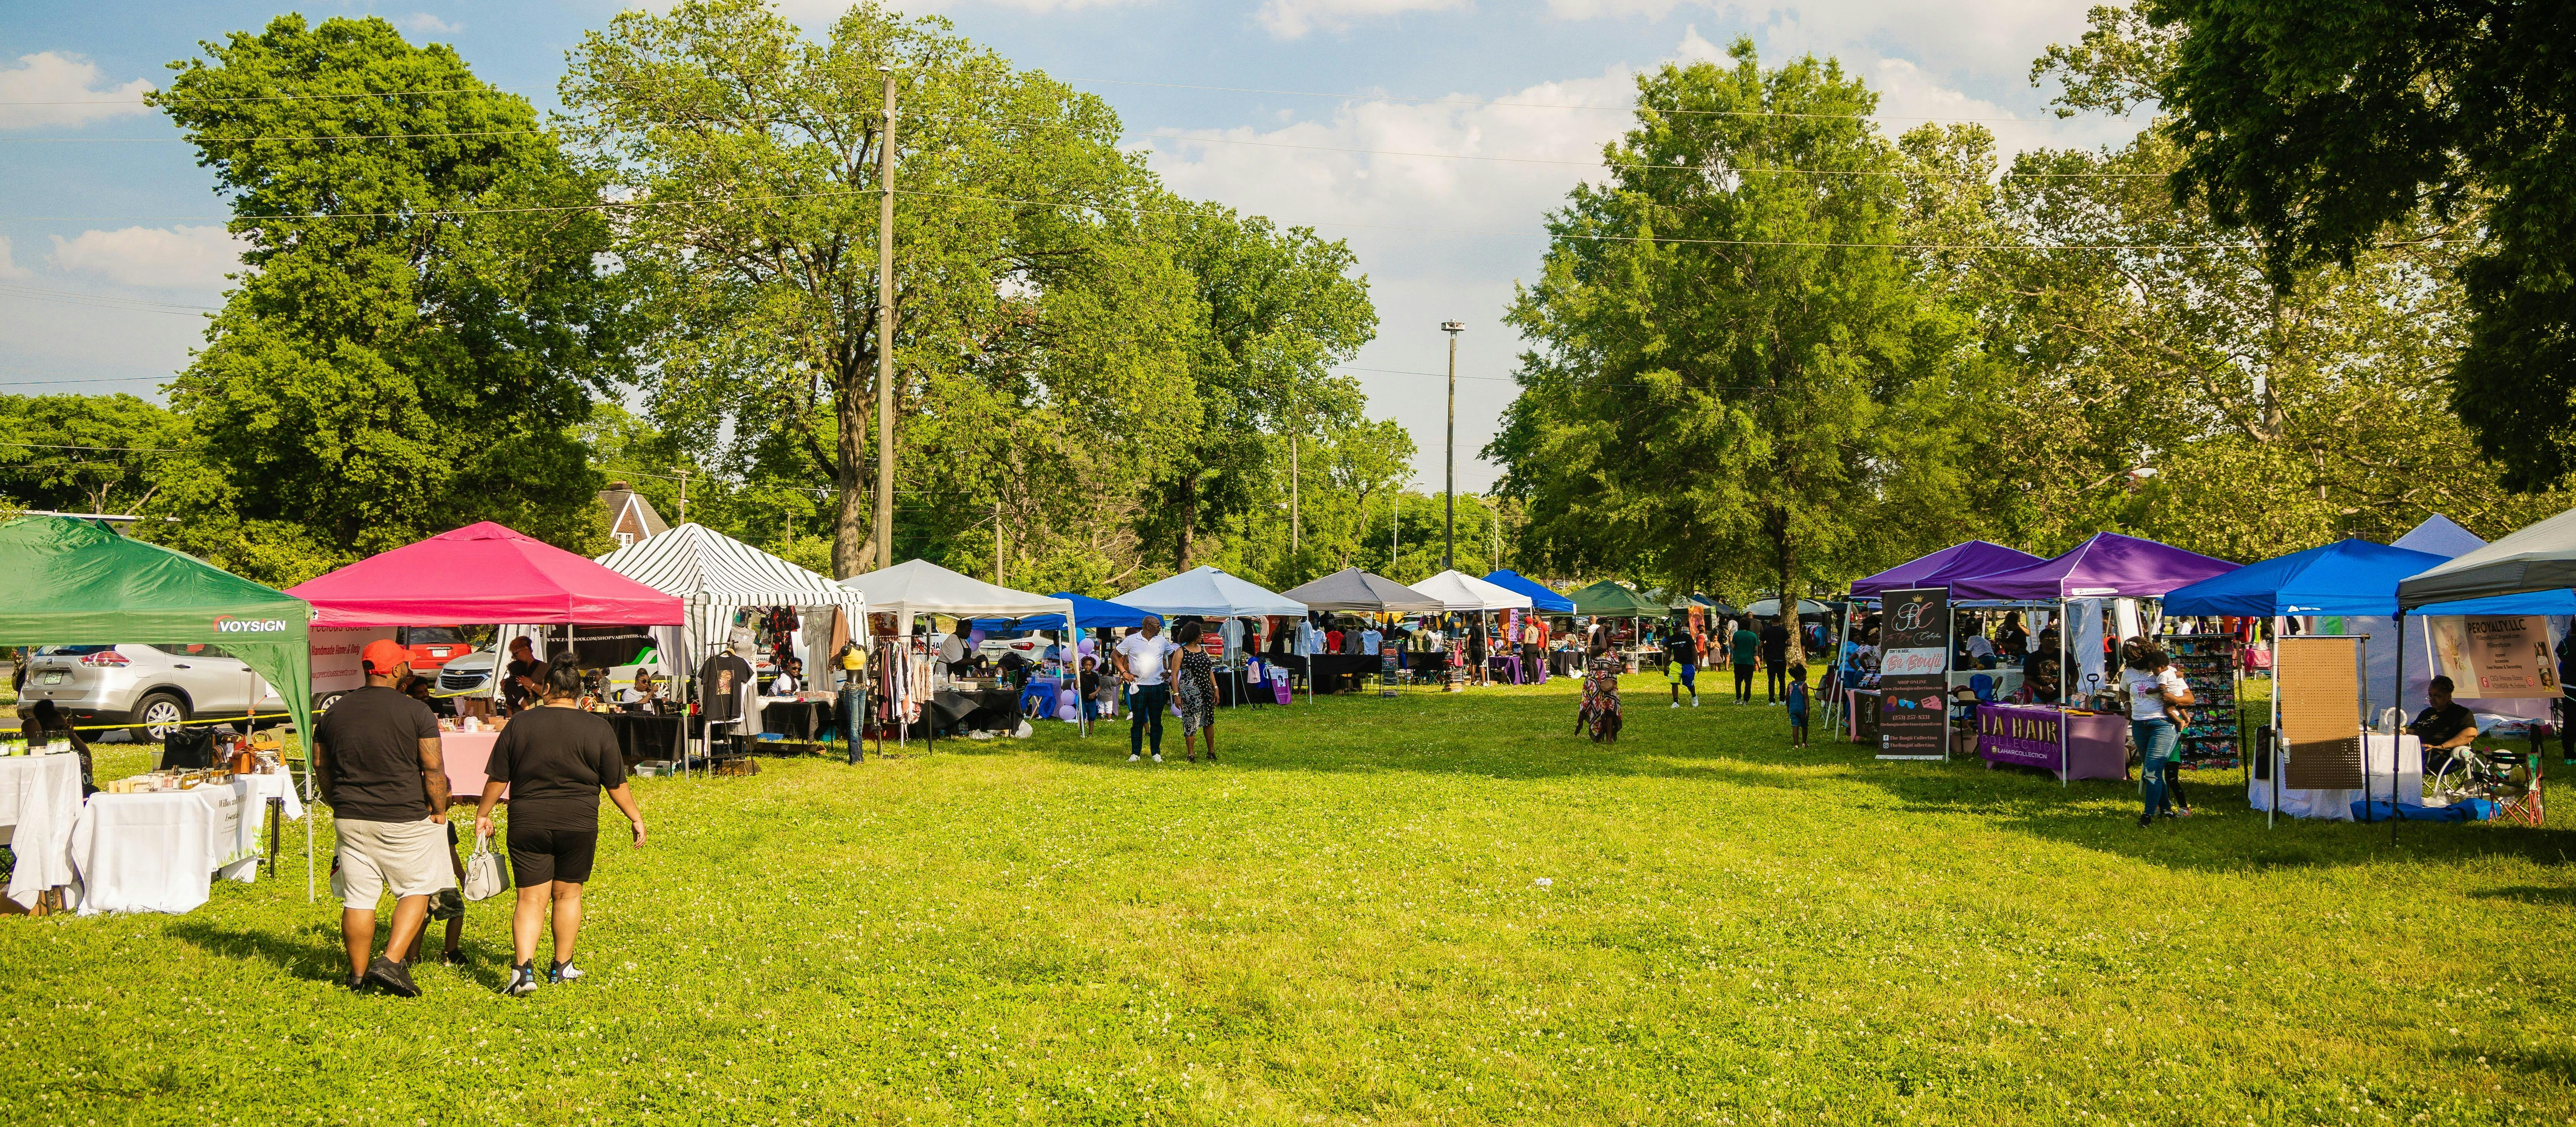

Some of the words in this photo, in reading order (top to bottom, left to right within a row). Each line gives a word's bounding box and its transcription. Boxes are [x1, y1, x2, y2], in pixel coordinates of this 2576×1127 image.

[2468, 619, 2526, 633] PEROYALTY.LLC
[312, 645, 335, 655] Handmade
[335, 645, 347, 654] Home
[347, 644, 350, 654] &
[1886, 655, 1904, 671] Be
[1983, 714, 2004, 736] LA
[2013, 717, 2057, 744] HAIR
[1982, 735, 2058, 753] COLLECTION
[1998, 749, 2047, 759] LAHAIRCOLLECTION
